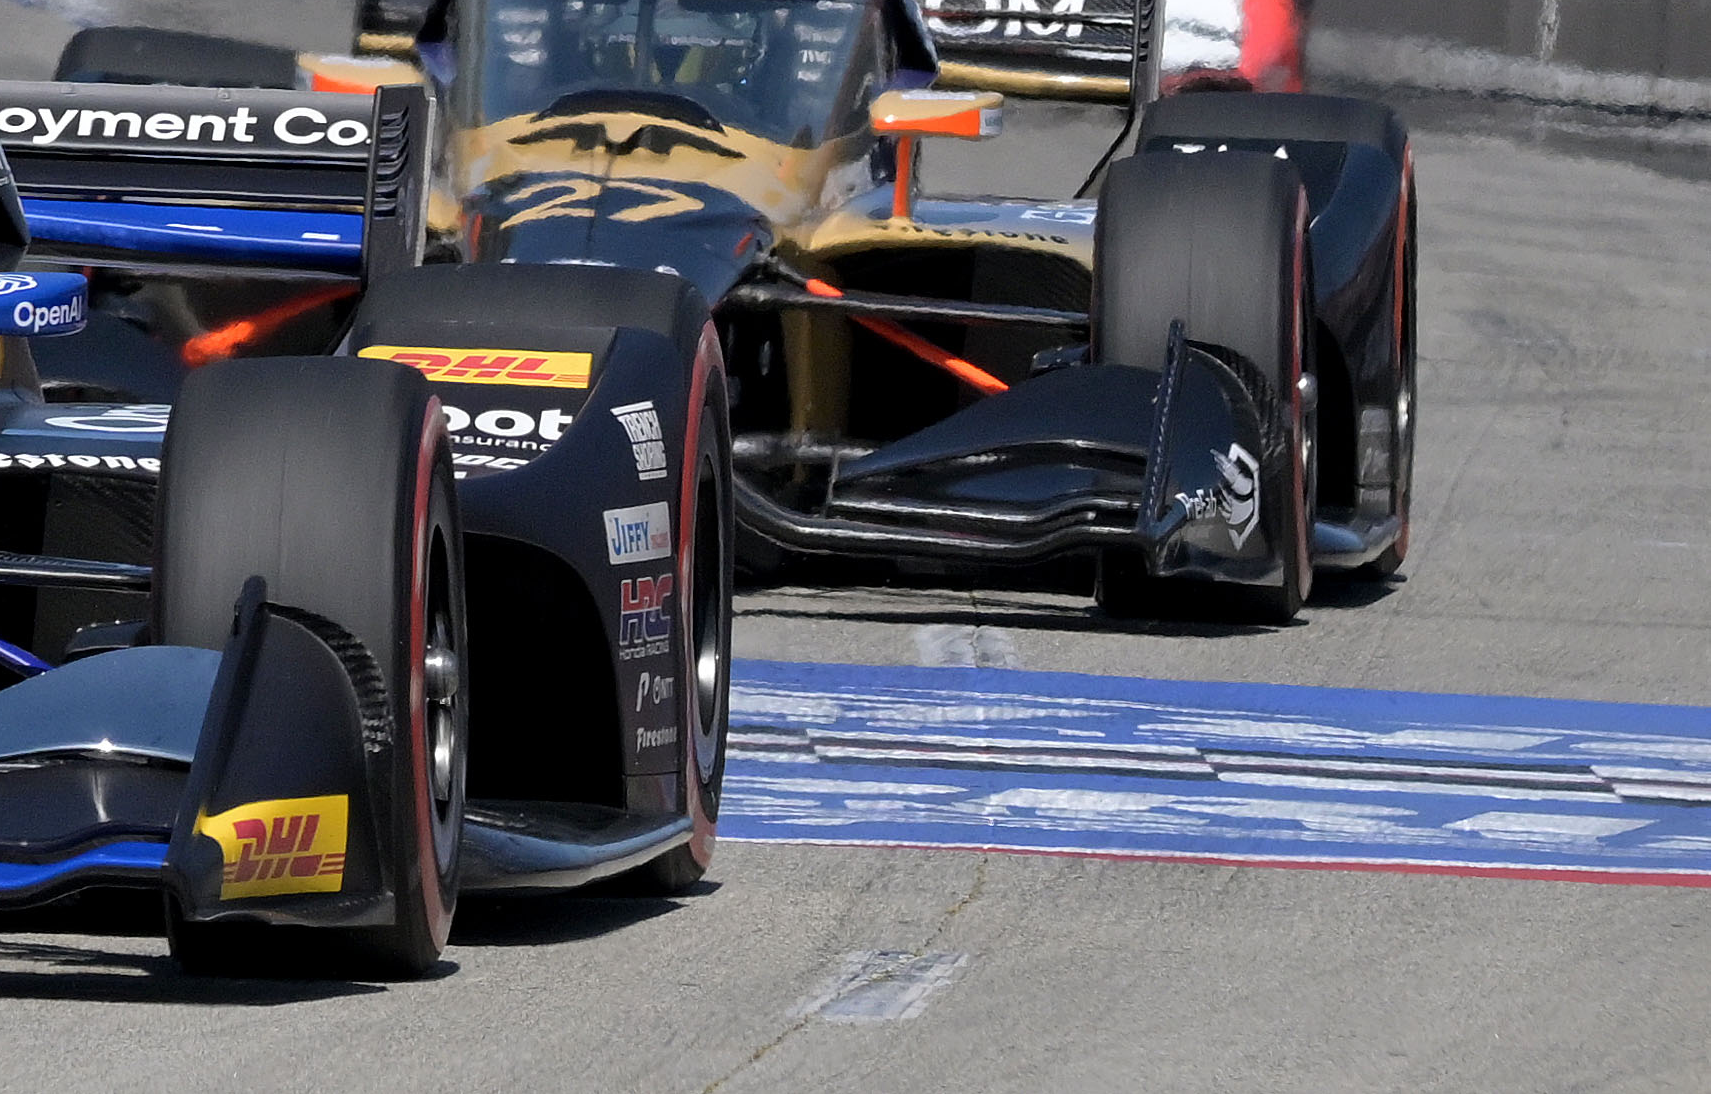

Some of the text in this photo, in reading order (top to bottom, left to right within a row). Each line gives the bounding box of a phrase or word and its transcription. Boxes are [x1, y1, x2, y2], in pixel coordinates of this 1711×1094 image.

[499, 179, 706, 230] 27
[13, 295, 82, 333] OpenAI
[391, 353, 556, 380] DHL
